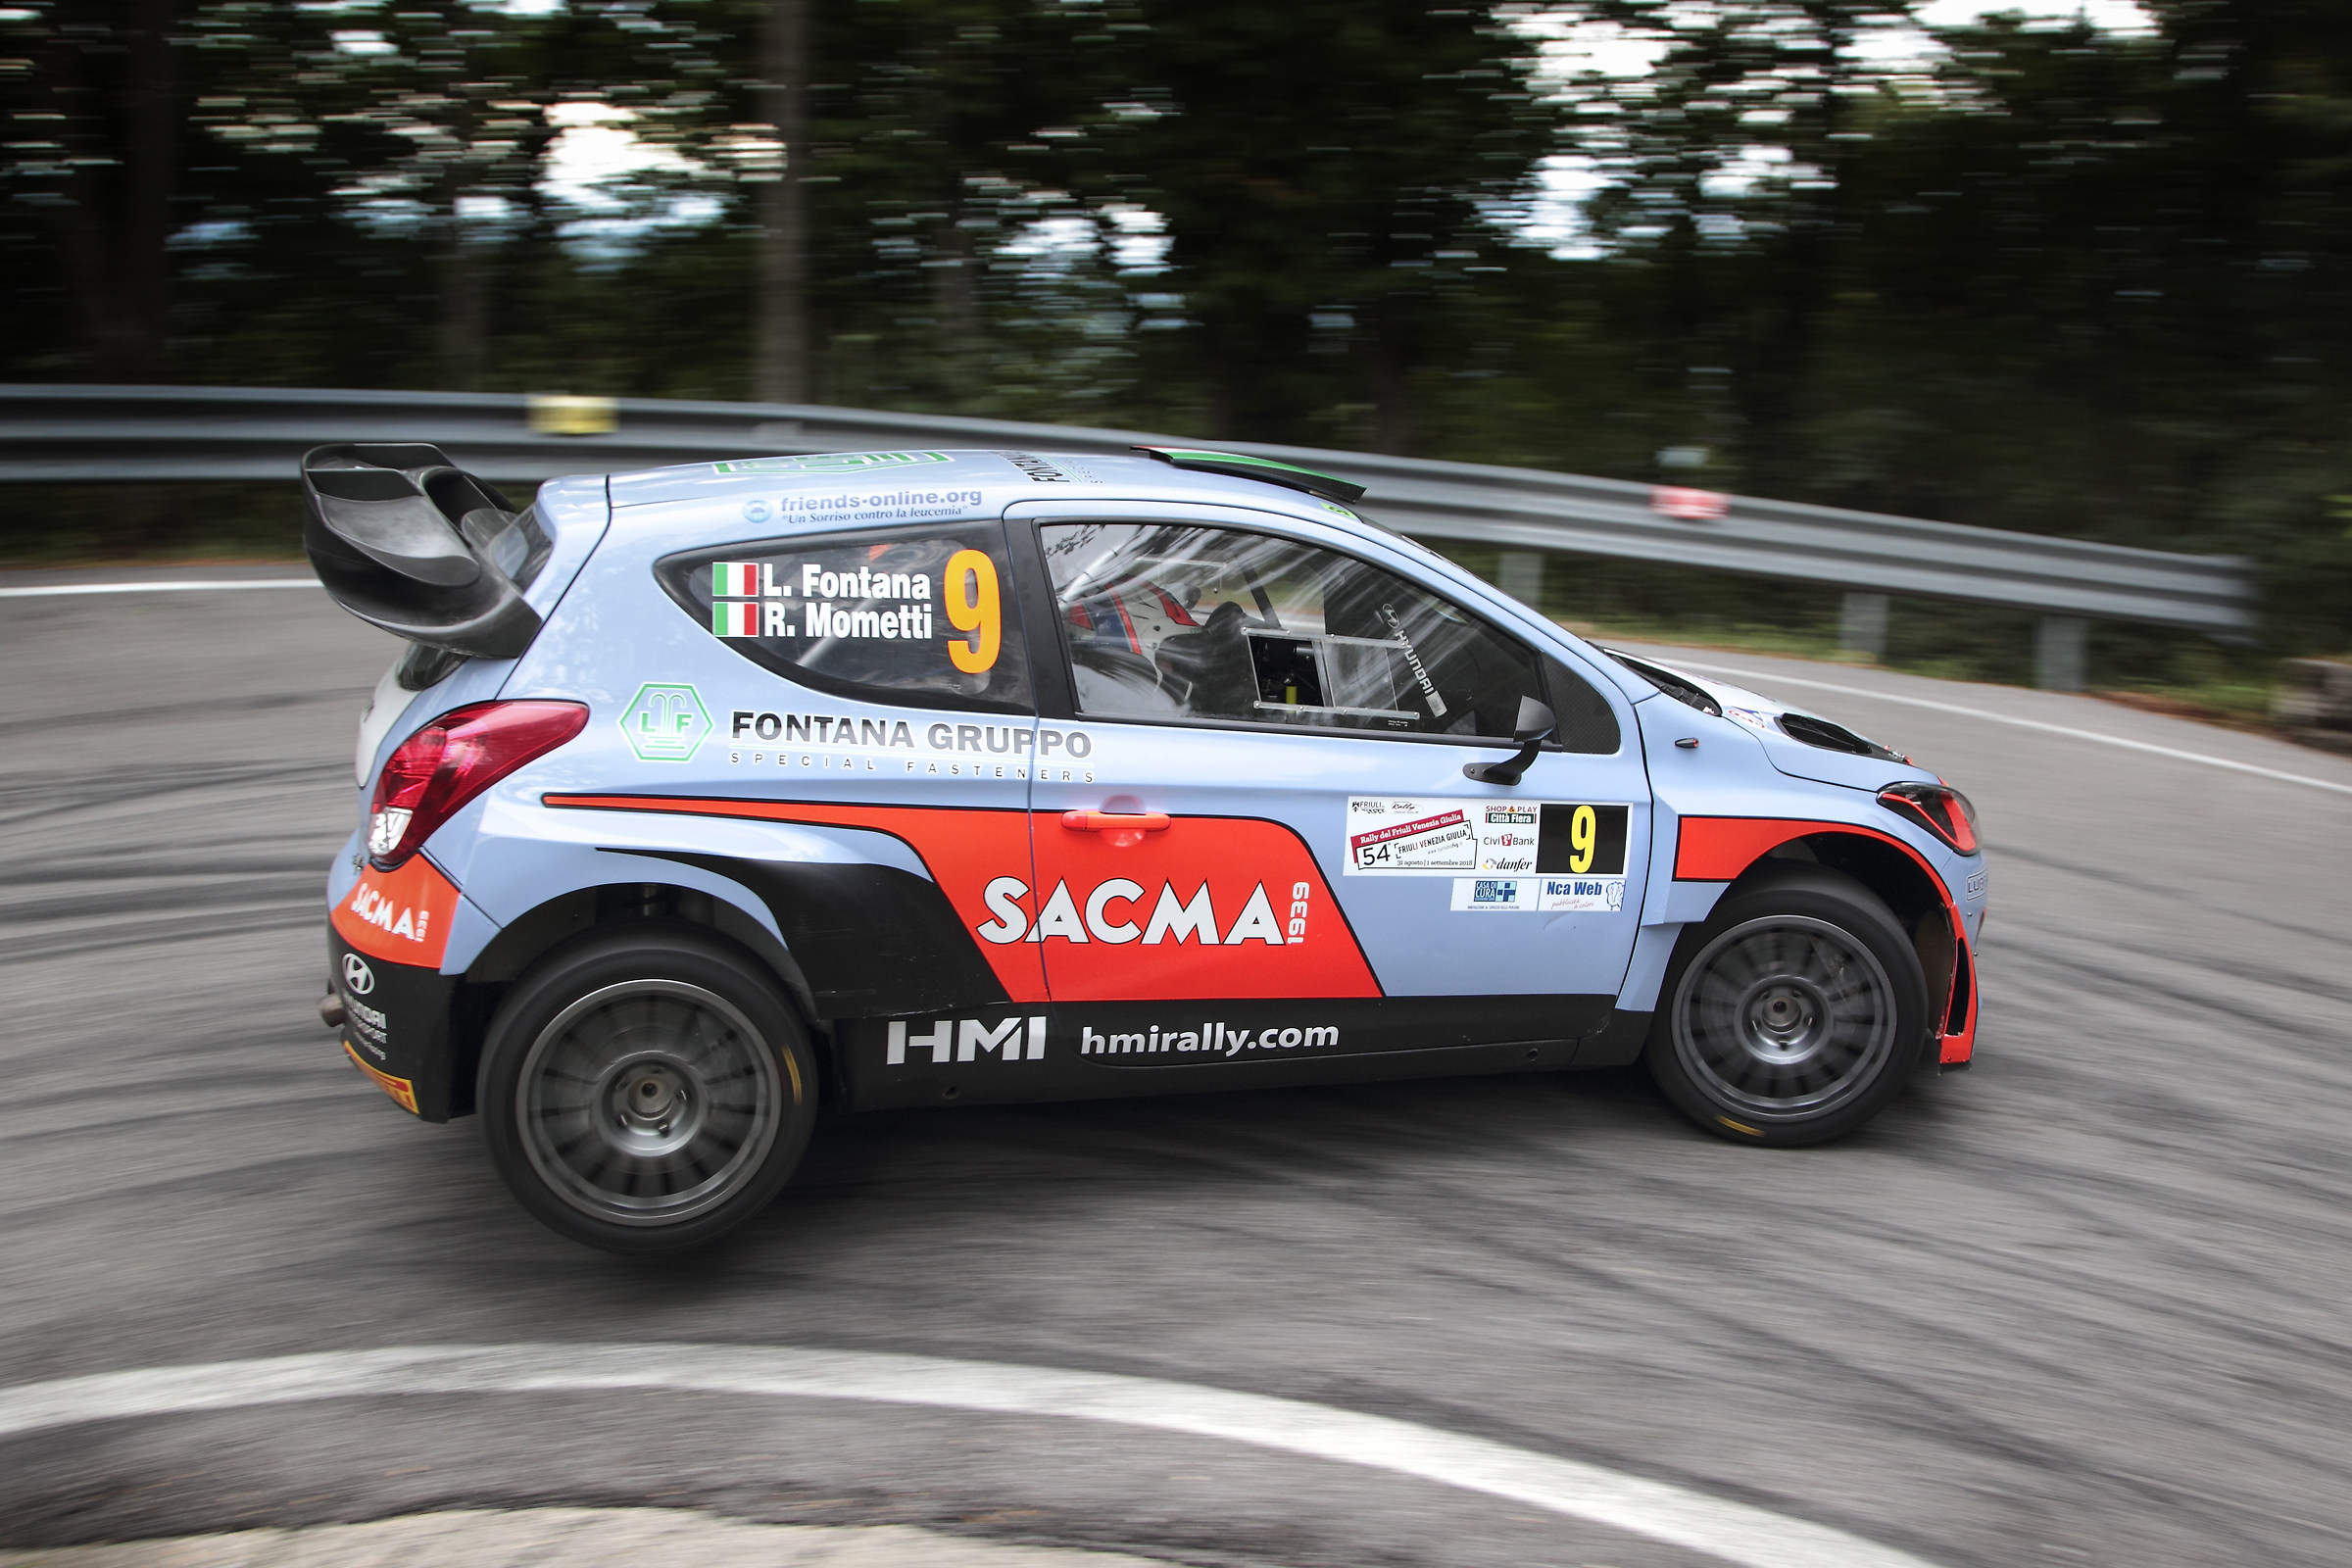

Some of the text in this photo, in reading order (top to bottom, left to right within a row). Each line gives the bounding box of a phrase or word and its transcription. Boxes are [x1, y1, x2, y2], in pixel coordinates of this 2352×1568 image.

[780, 490, 982, 512] friends-online.org
[809, 512, 851, 522] Sorriso
[855, 510, 893, 520] contro
[897, 508, 906, 517] la
[763, 564, 931, 600] L. Fontana
[764, 602, 932, 639] R. Mometti
[944, 549, 1002, 674] 9
[732, 710, 1092, 759] FONTANA GRUPPO
[731, 753, 1093, 783] SPECIAL FASTENERS
[1360, 813, 1462, 844] Rally del Friuli Venezia Giulia
[1491, 813, 1531, 823] Città Fiera
[1398, 829, 1467, 854] FRIULI VENEZIA GIULIA
[1570, 805, 1596, 874] 9
[1475, 888, 1495, 898] CURA
[1546, 881, 1602, 896] Nca Web
[351, 882, 416, 941] SACMA
[976, 875, 1286, 946] SACMA
[1287, 881, 1310, 945] 1939
[886, 1015, 1340, 1065] HMI hmirally.com
